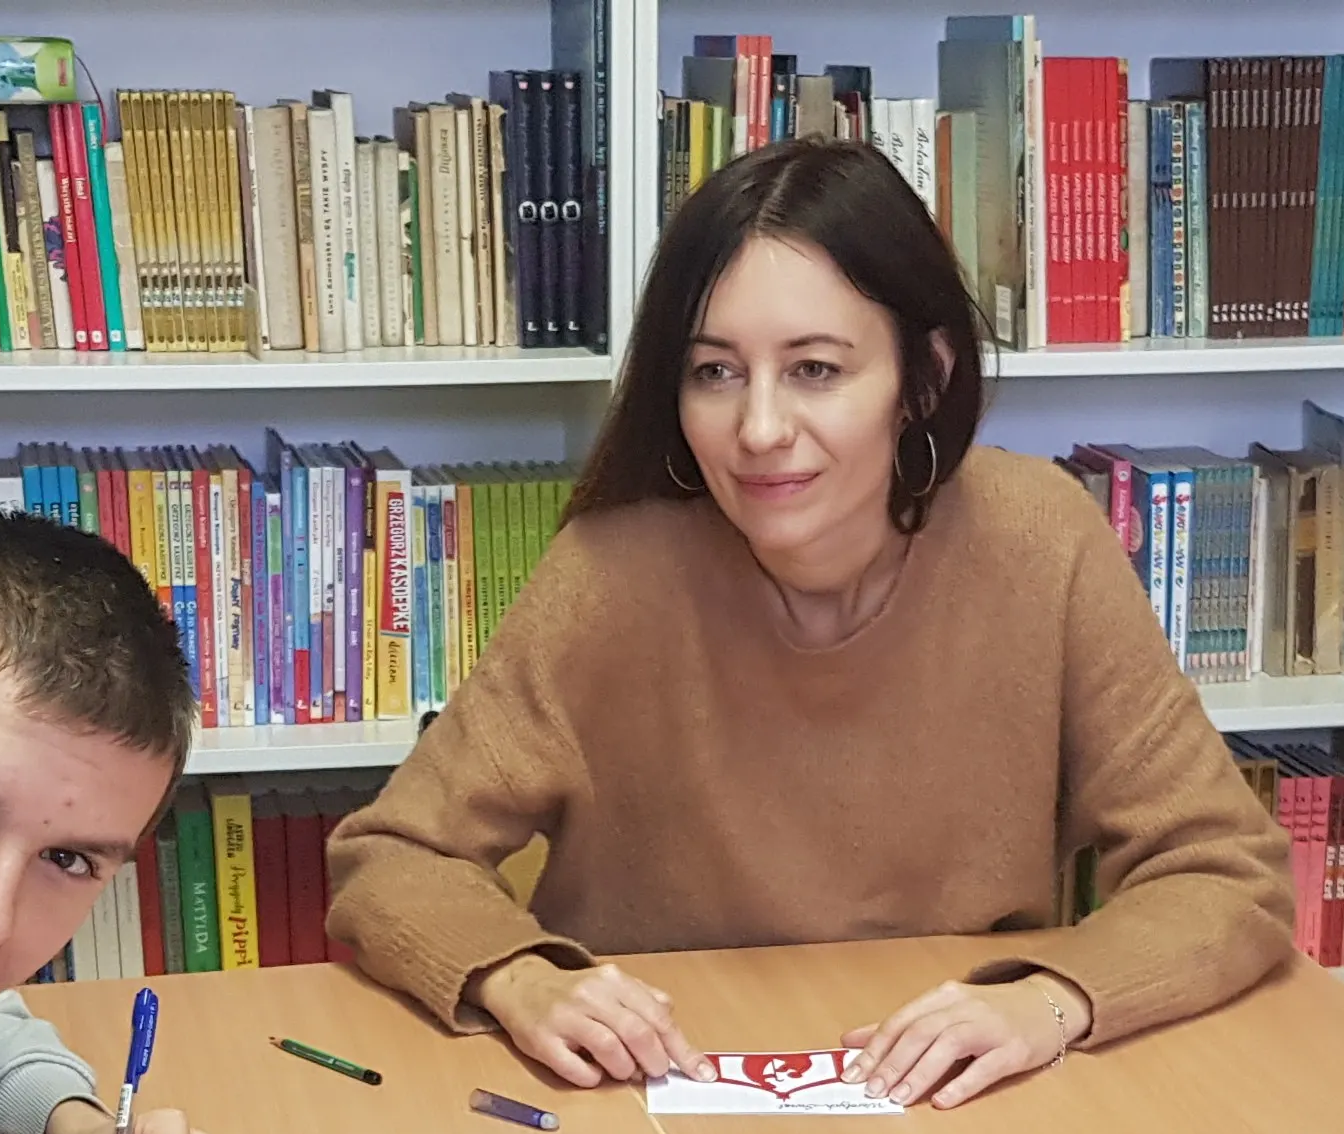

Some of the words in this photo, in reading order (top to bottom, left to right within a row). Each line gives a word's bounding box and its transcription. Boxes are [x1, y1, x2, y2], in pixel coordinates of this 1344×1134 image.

[321, 149, 329, 181] WYSPY
[171, 504, 180, 542] GRZEGORZ
[184, 504, 193, 542] GRZEGORZ
[390, 499, 407, 558] GRZEGORZ
[391, 558, 410, 630] KASDEPKE
[192, 882, 209, 953] MATYLDA
